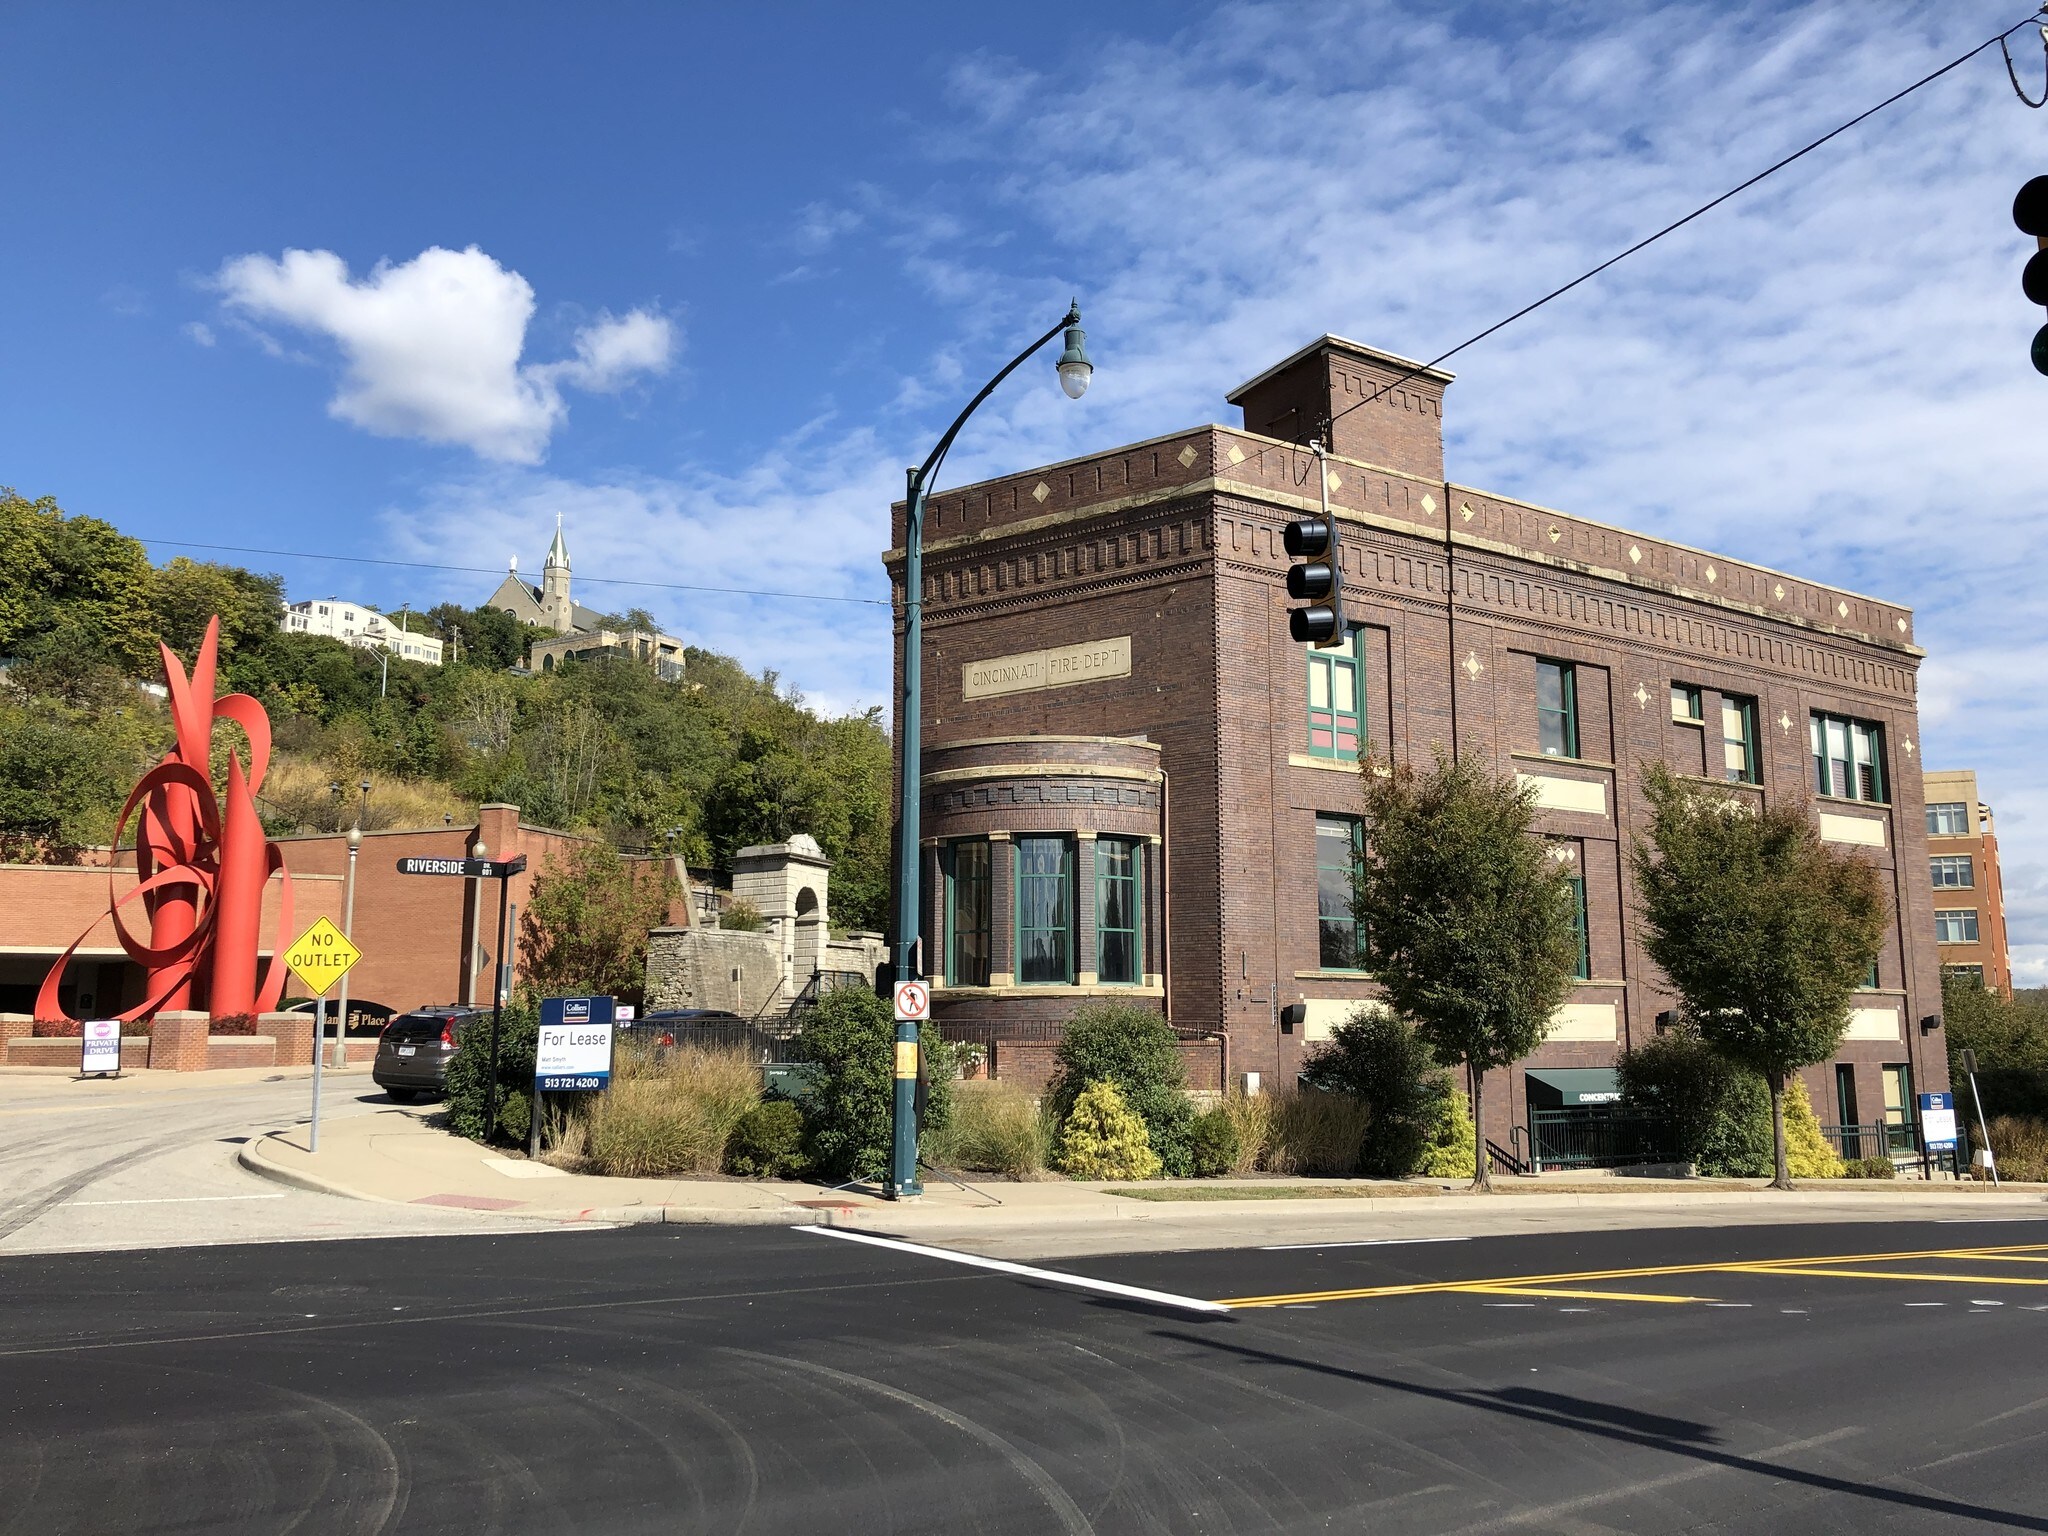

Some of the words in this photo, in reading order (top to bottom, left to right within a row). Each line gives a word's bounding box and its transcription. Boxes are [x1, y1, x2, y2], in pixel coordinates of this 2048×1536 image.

[1050, 655, 1079, 675] FIRE
[406, 859, 465, 874] RIVERSIDE
[311, 933, 333, 947] NO
[292, 953, 351, 967] OUTLET
[566, 1003, 587, 1011] Colliers
[361, 1013, 386, 1026] Place
[543, 1032, 565, 1046] For
[569, 1031, 606, 1046] Lease
[544, 1078, 559, 1088] 513
[560, 1078, 574, 1088] 721
[576, 1077, 599, 1088] 4200
